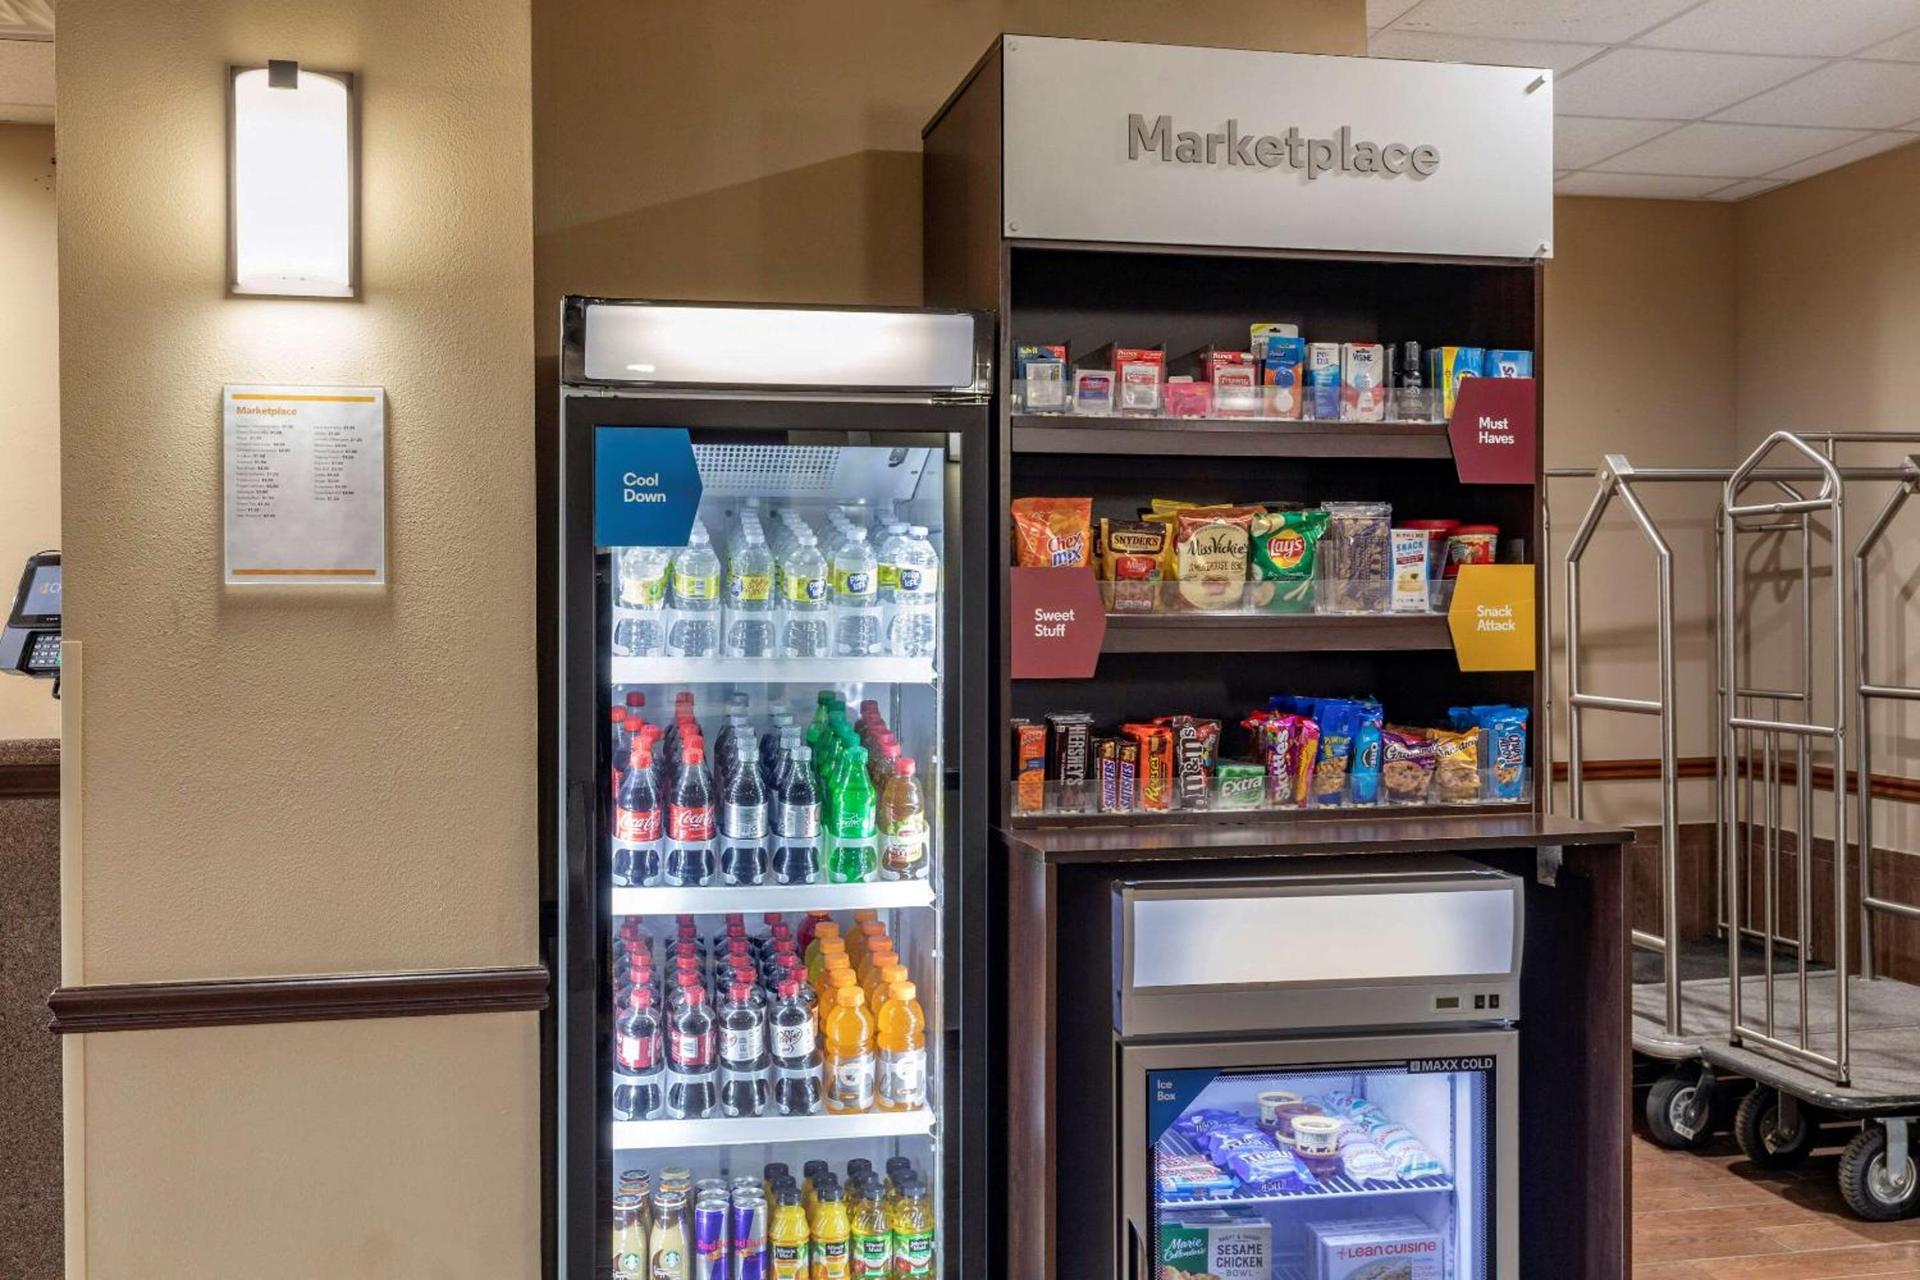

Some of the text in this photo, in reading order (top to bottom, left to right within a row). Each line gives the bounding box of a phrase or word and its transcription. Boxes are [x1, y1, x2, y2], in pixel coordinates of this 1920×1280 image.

[1128, 113, 1440, 180] Marketplace
[236, 406, 298, 416] Marketplace
[1479, 416, 1508, 429] Must
[1479, 431, 1514, 445] Haves
[623, 472, 659, 486] Cool
[624, 489, 666, 503] Down
[1034, 608, 1075, 622] Sweet
[1476, 604, 1512, 617] Snack
[1034, 624, 1066, 637] Stuff
[1477, 618, 1516, 632] Attack
[1421, 1057, 1494, 1072] MAXX COLD
[1157, 1079, 1173, 1090] Ice
[1157, 1091, 1176, 1101] Box
[1217, 1243, 1263, 1256] SESAME
[1216, 1256, 1263, 1268] CHICKEN
[1226, 1269, 1253, 1277] BOWL
